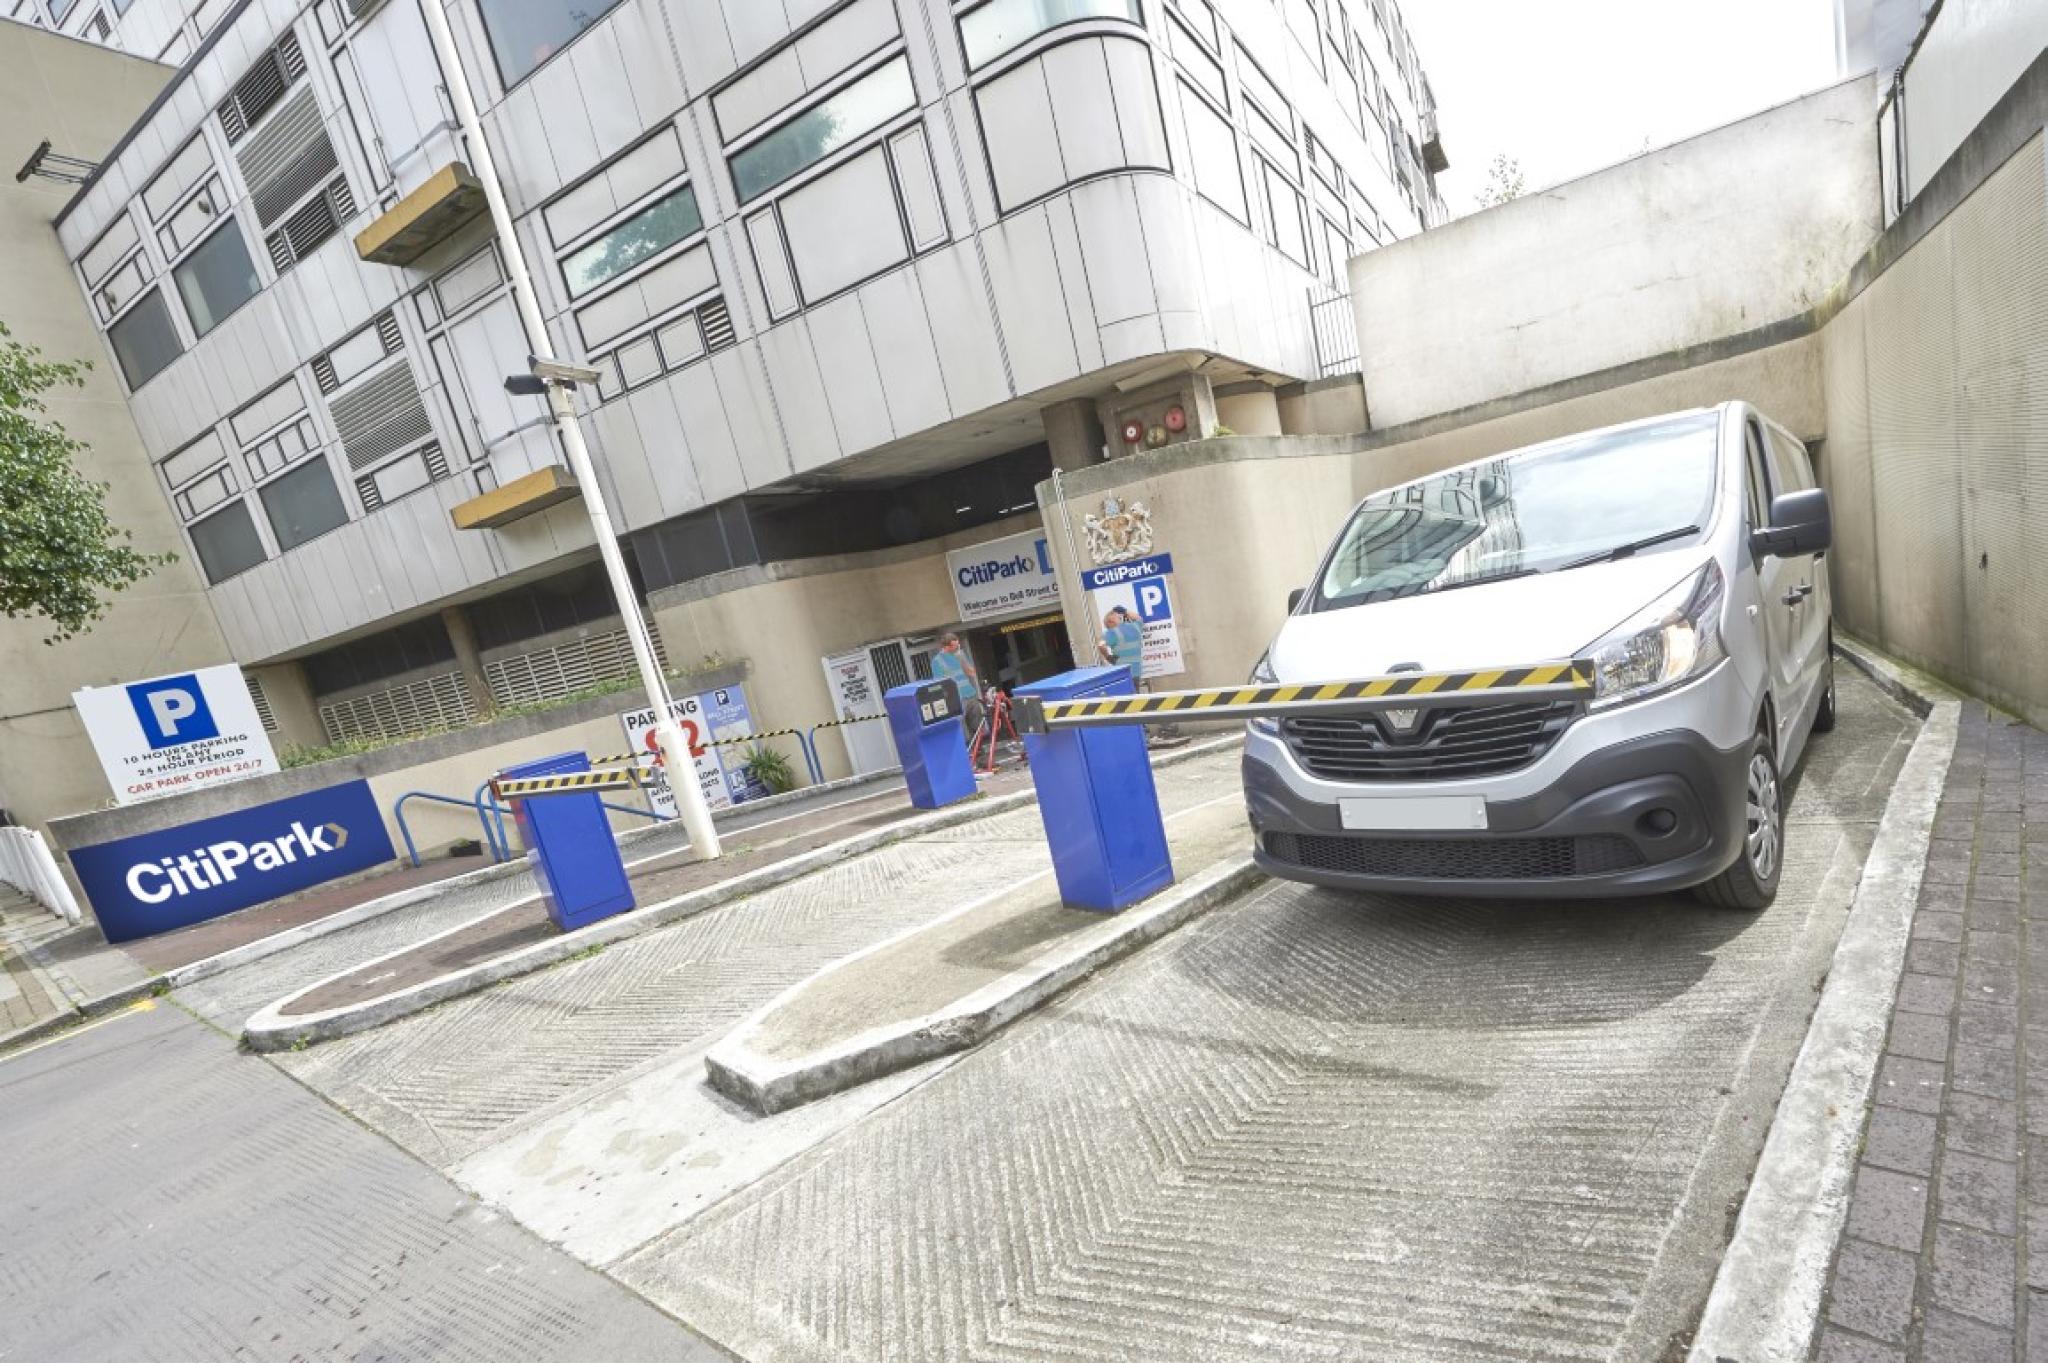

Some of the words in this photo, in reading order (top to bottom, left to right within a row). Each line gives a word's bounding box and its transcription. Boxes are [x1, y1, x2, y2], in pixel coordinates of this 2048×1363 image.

[958, 555, 1029, 588] CitiPark
[1093, 560, 1152, 586] CitiPark
[963, 598, 998, 611] Welcome
[1141, 585, 1163, 617] P
[145, 688, 196, 737] P
[626, 700, 698, 730] PARING
[123, 755, 139, 765] 10
[142, 746, 188, 761] HOURS
[191, 733, 248, 750] PARKING
[158, 759, 195, 773] HOUR
[199, 748, 244, 763] PERIOD
[128, 782, 154, 794] CAR
[156, 773, 192, 788] PARK
[195, 765, 231, 780] OPEN
[126, 821, 333, 904] CitiPark
